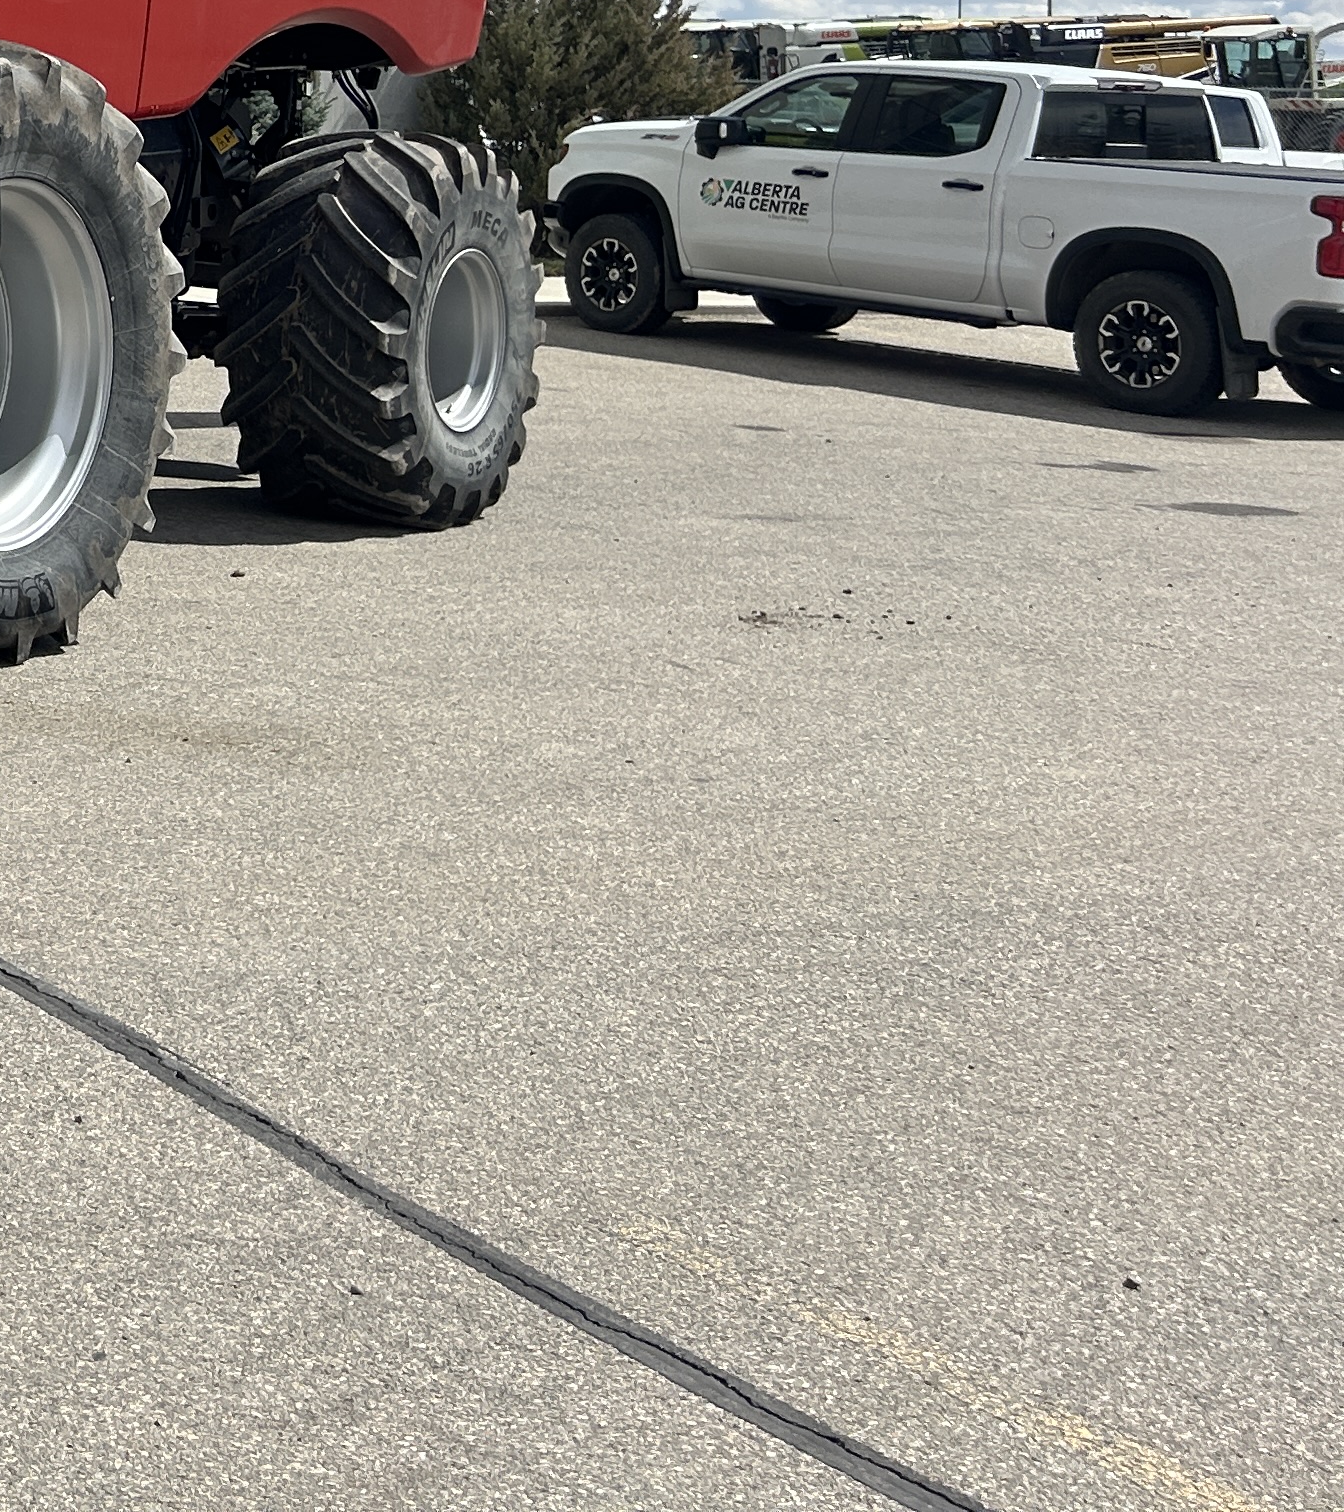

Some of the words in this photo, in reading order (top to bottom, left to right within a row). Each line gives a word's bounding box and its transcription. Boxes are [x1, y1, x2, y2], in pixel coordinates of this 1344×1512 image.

[1064, 28, 1103, 41] CLAAS
[731, 180, 801, 200] ALBERTA
[724, 195, 745, 209] AG
[749, 197, 809, 216] CENTRE
